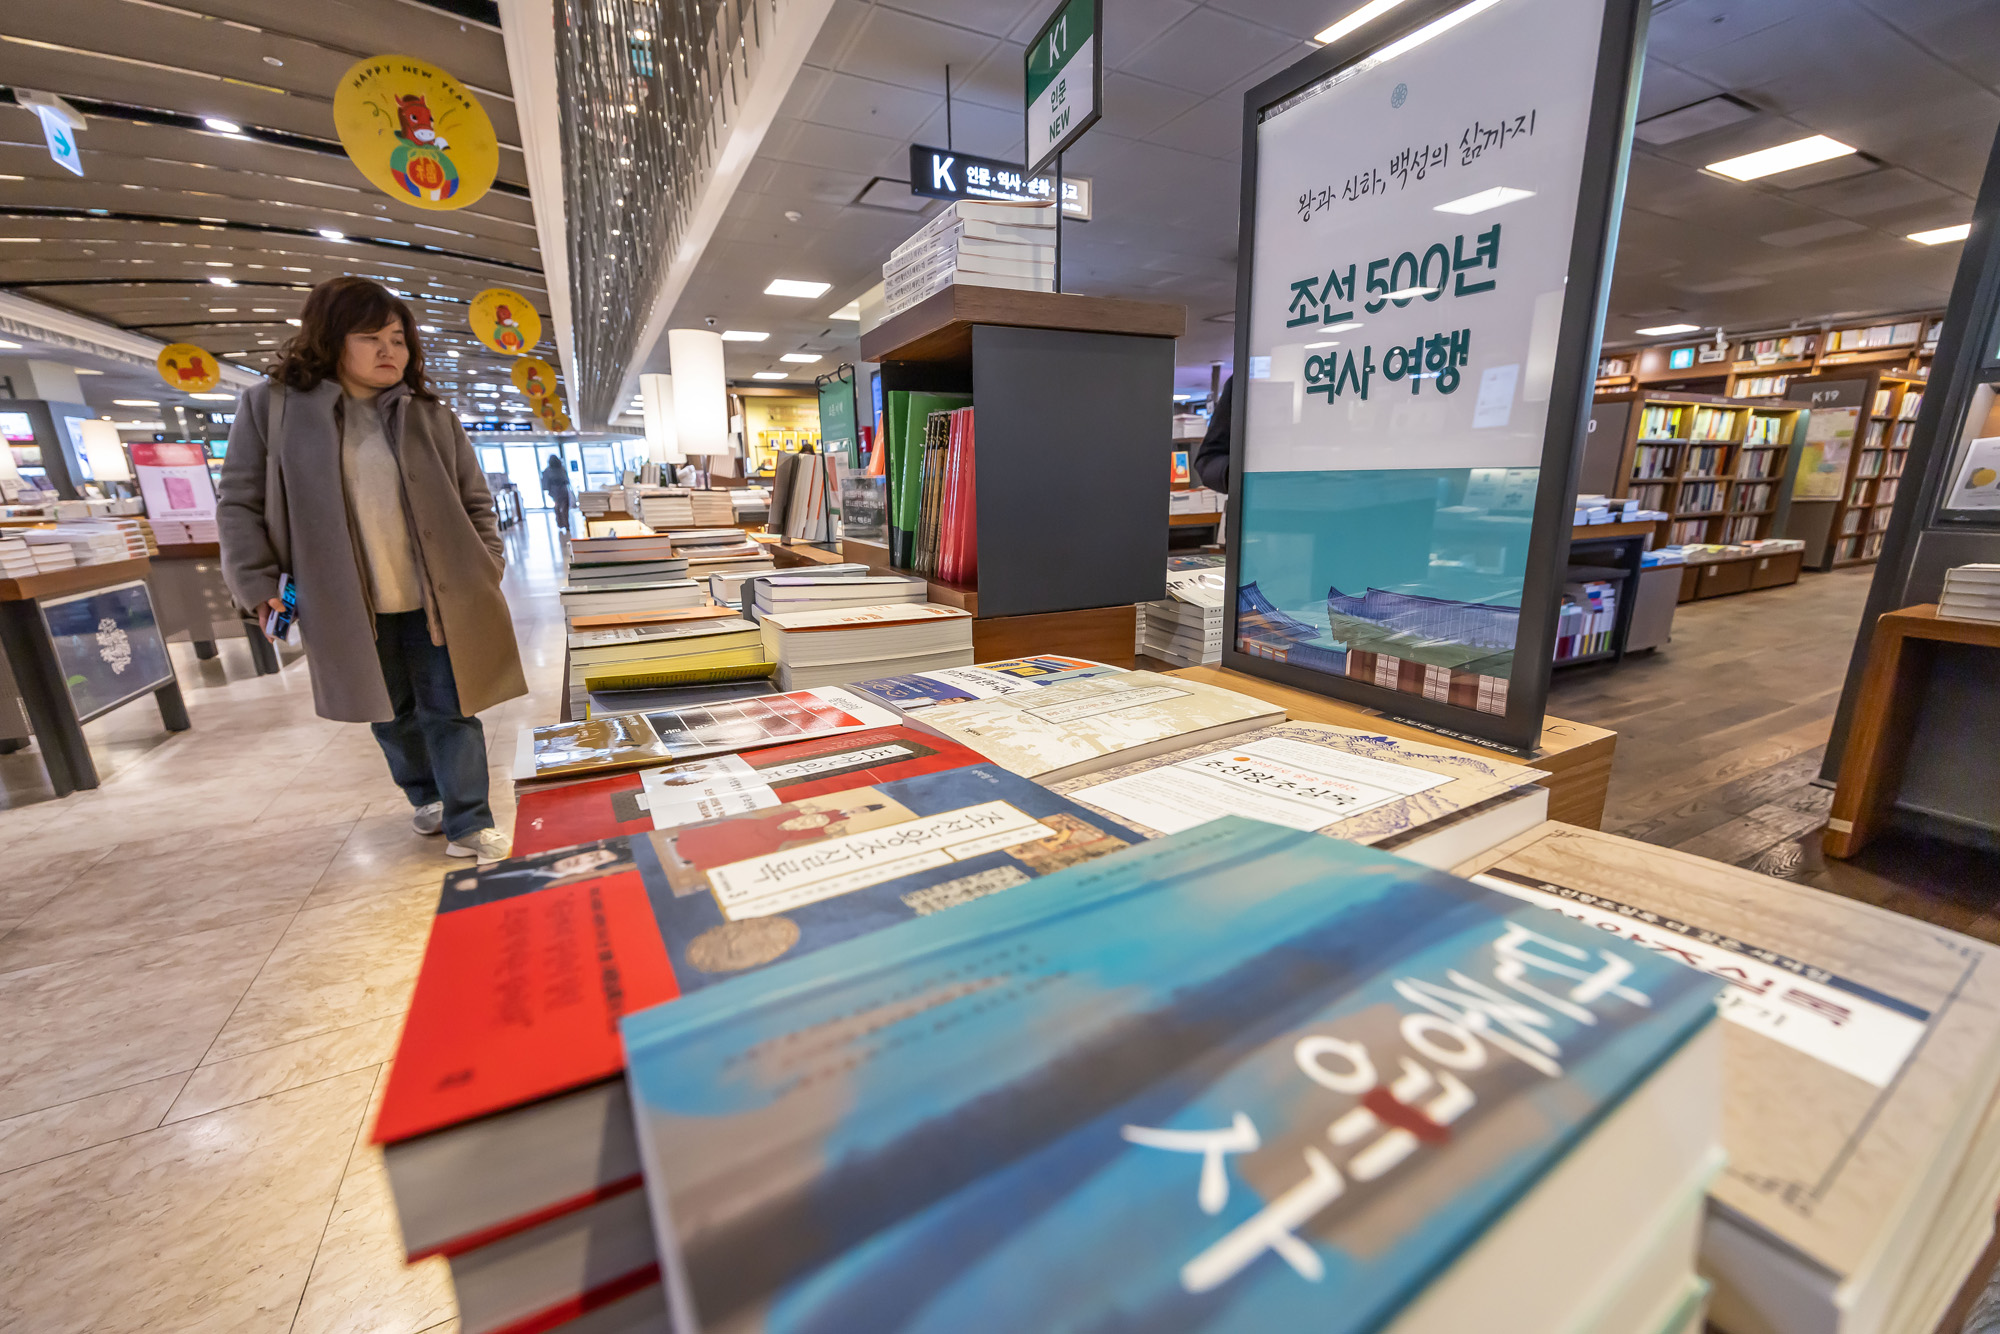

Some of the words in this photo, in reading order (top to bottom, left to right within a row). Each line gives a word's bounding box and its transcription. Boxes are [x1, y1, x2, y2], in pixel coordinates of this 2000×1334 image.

[1049, 14, 1067, 68] K1
[353, 65, 391, 88] HAPPY
[402, 65, 432, 79] NEW
[442, 81, 471, 109] YEAR
[1050, 78, 1067, 113] 인문
[1049, 105, 1071, 143] NEW
[415, 158, 438, 184] 福
[932, 154, 957, 192] K
[1298, 186, 1336, 222] 왕과
[1390, 143, 1449, 190] 백성의
[1459, 109, 1536, 166] 삶까지
[1286, 264, 1356, 328] 조선
[1364, 223, 1501, 314] 500년
[1304, 346, 1376, 405] 역사
[1383, 328, 1471, 395] 여행
[1812, 389, 1840, 402] K19
[1587, 419, 1597, 433] 0
[1195, 759, 1357, 806] 조선왕조실록
[754, 810, 1006, 884] 조선왕조실록
[1119, 920, 1652, 1295] 단종애사
